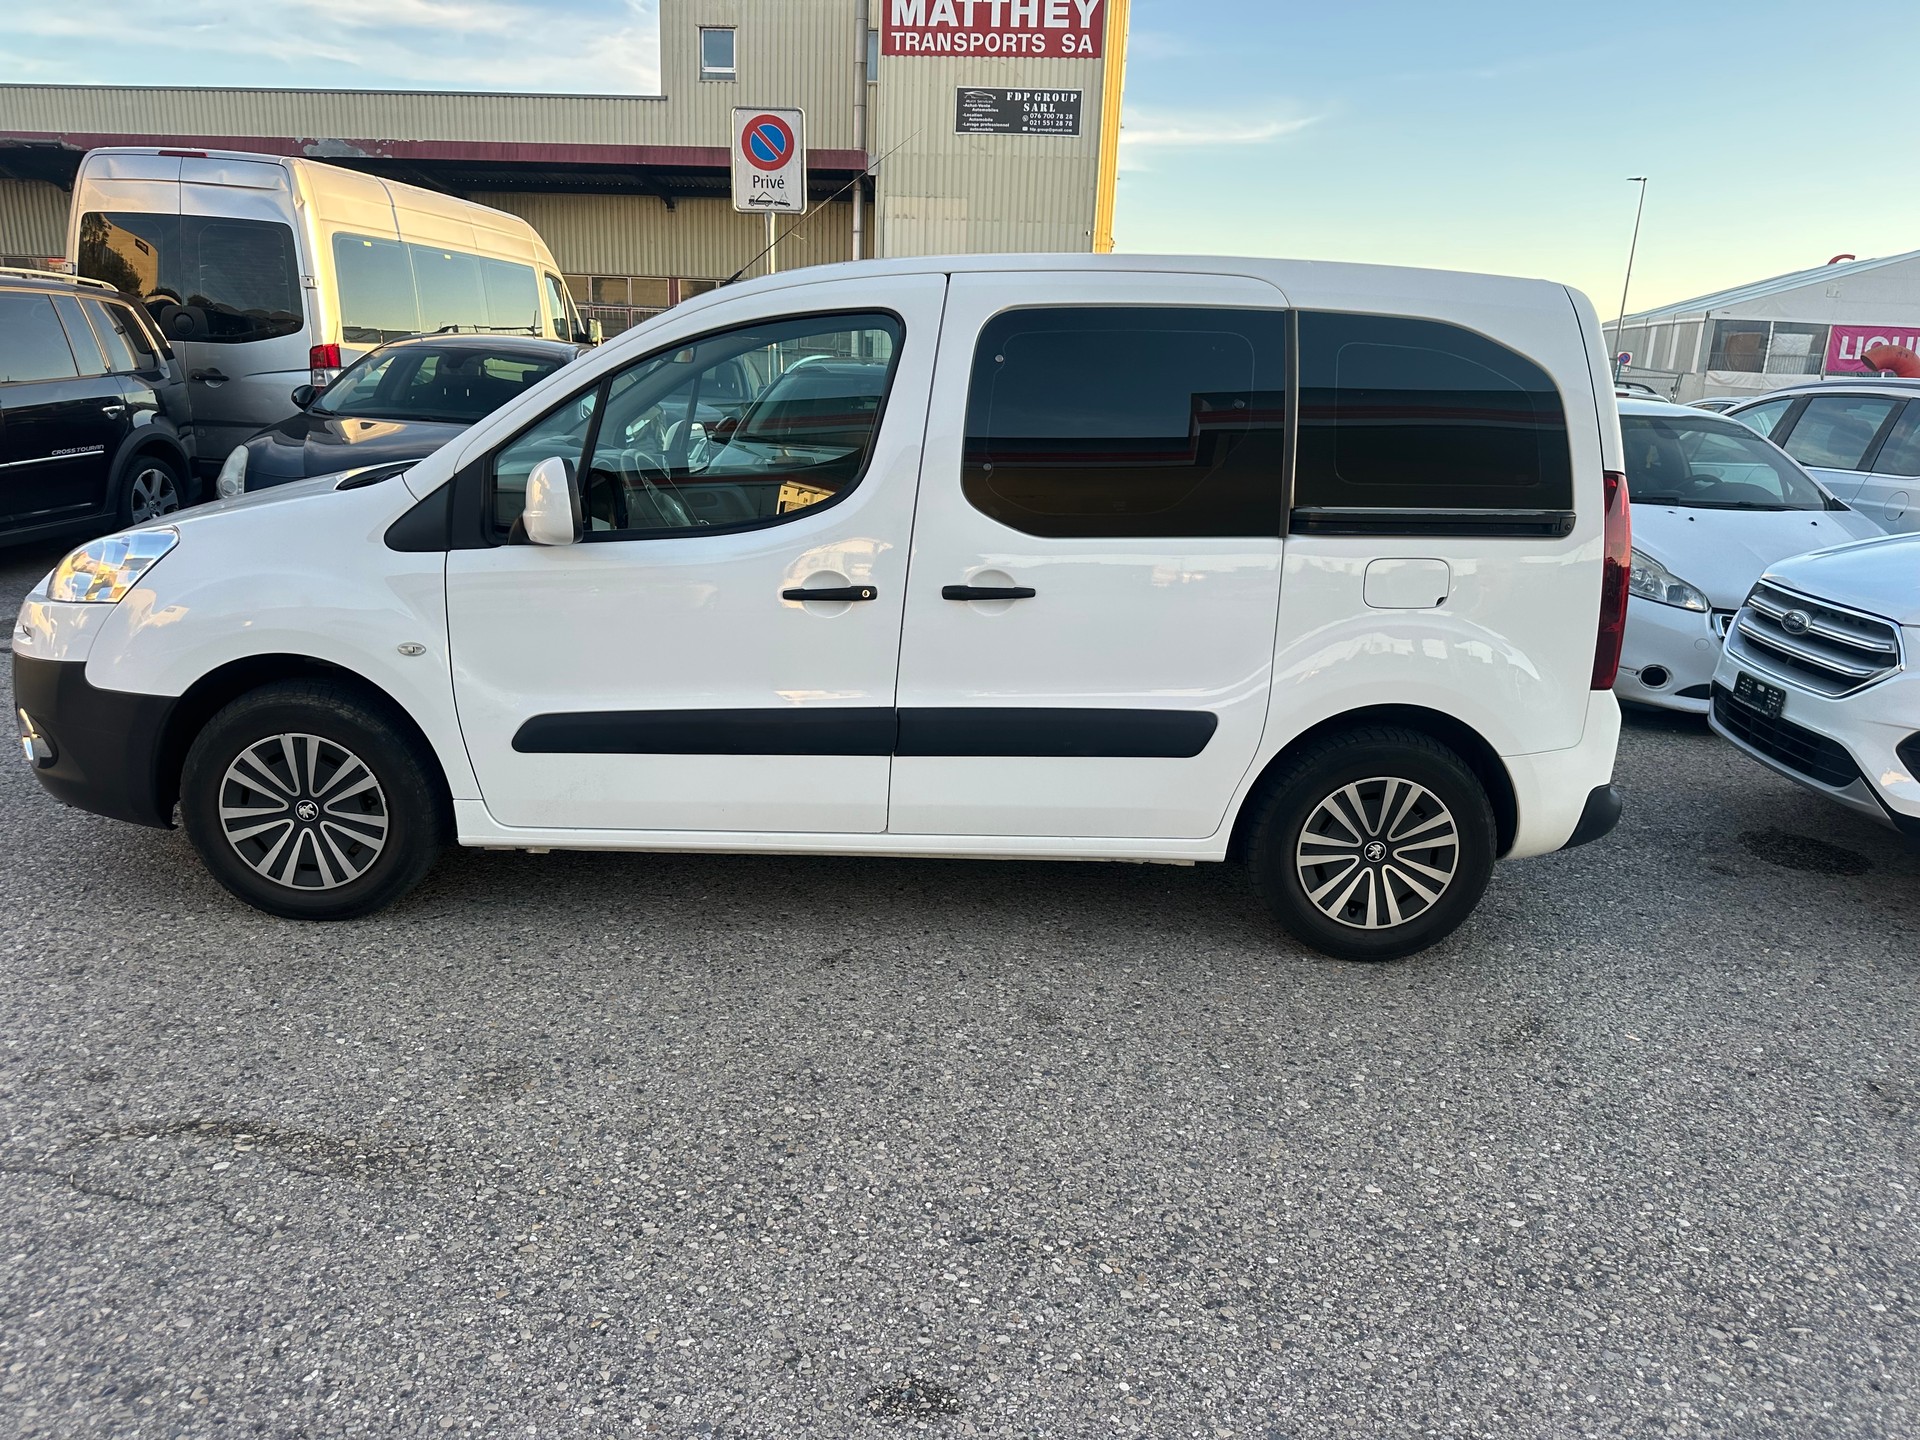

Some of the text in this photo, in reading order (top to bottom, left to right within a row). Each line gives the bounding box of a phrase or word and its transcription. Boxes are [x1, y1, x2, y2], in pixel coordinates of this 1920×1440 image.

[891, 0, 1099, 28] MATTHEY
[891, 32, 1093, 53] TRANSPORTS SA
[1006, 92, 1078, 102] FDP GROUP
[1023, 103, 1056, 112] SARL
[752, 175, 785, 189] Privé
